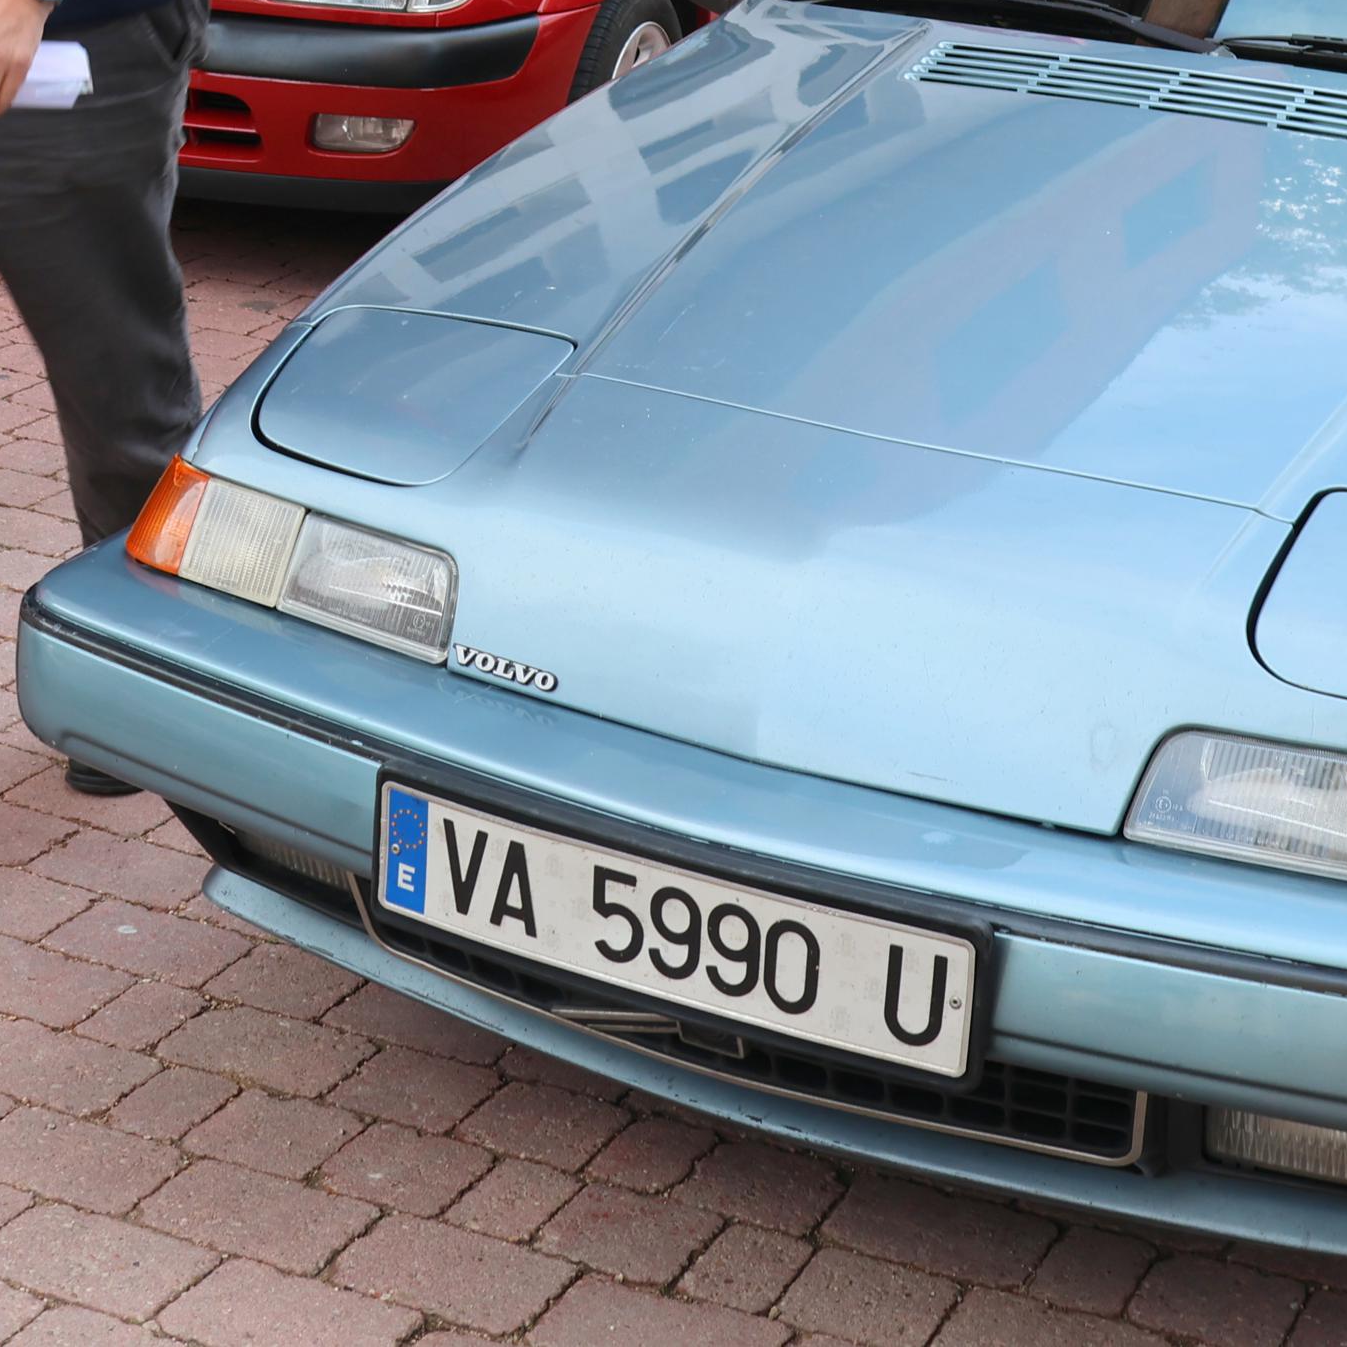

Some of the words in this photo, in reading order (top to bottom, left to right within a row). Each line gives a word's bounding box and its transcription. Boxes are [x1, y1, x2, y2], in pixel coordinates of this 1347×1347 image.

[454, 643, 557, 692] VOLVO
[397, 861, 416, 893] E
[442, 817, 538, 939] VA
[592, 864, 821, 1016] 5990
[884, 944, 949, 1047] U
